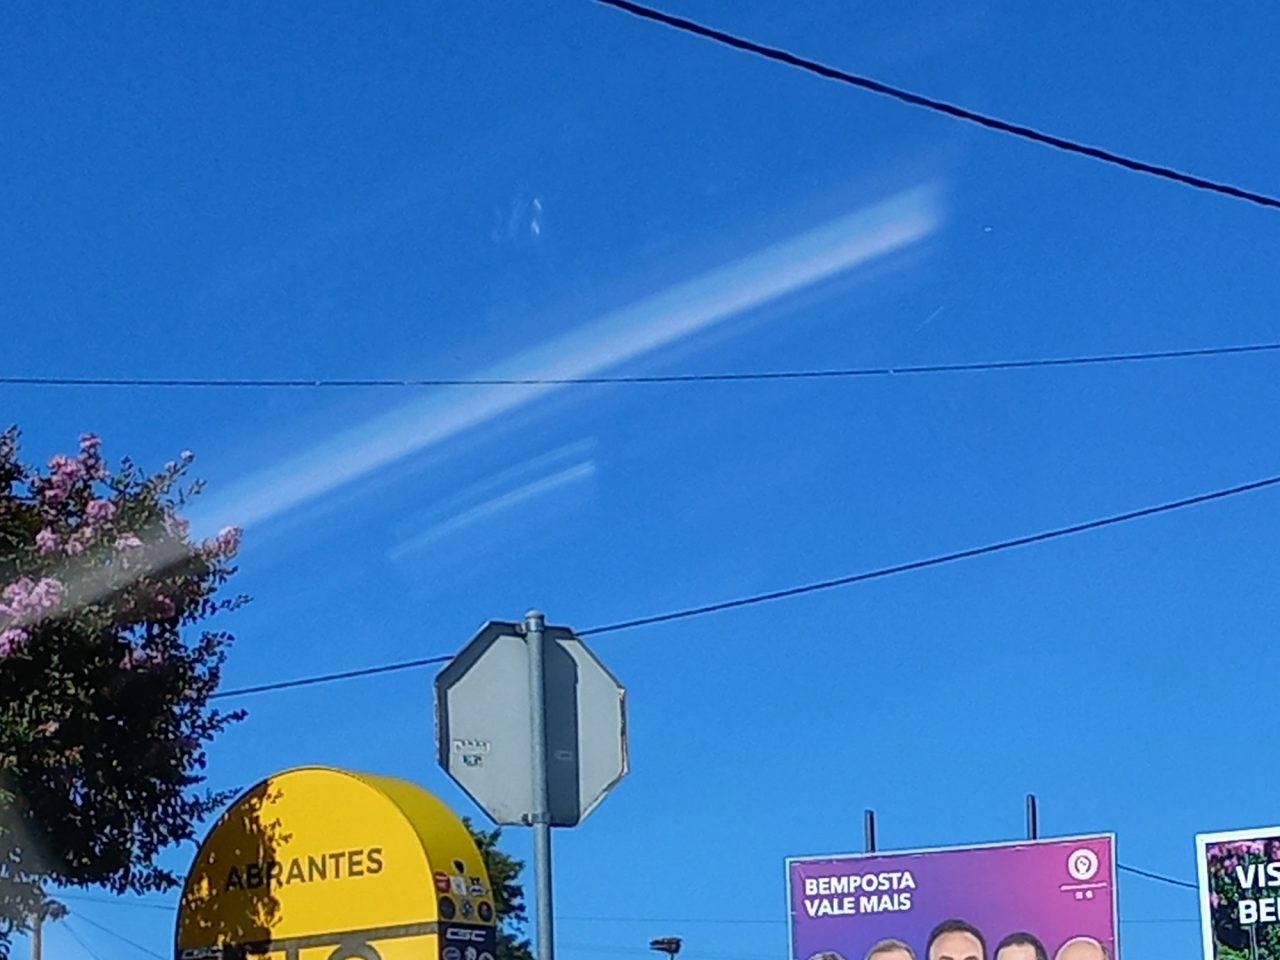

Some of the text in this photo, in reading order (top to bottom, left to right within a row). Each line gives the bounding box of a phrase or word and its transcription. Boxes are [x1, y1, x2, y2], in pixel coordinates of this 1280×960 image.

[224, 847, 384, 892] ABRANTES
[804, 871, 916, 896] BEMPOSTA
[804, 892, 912, 917] VALE MAIS
